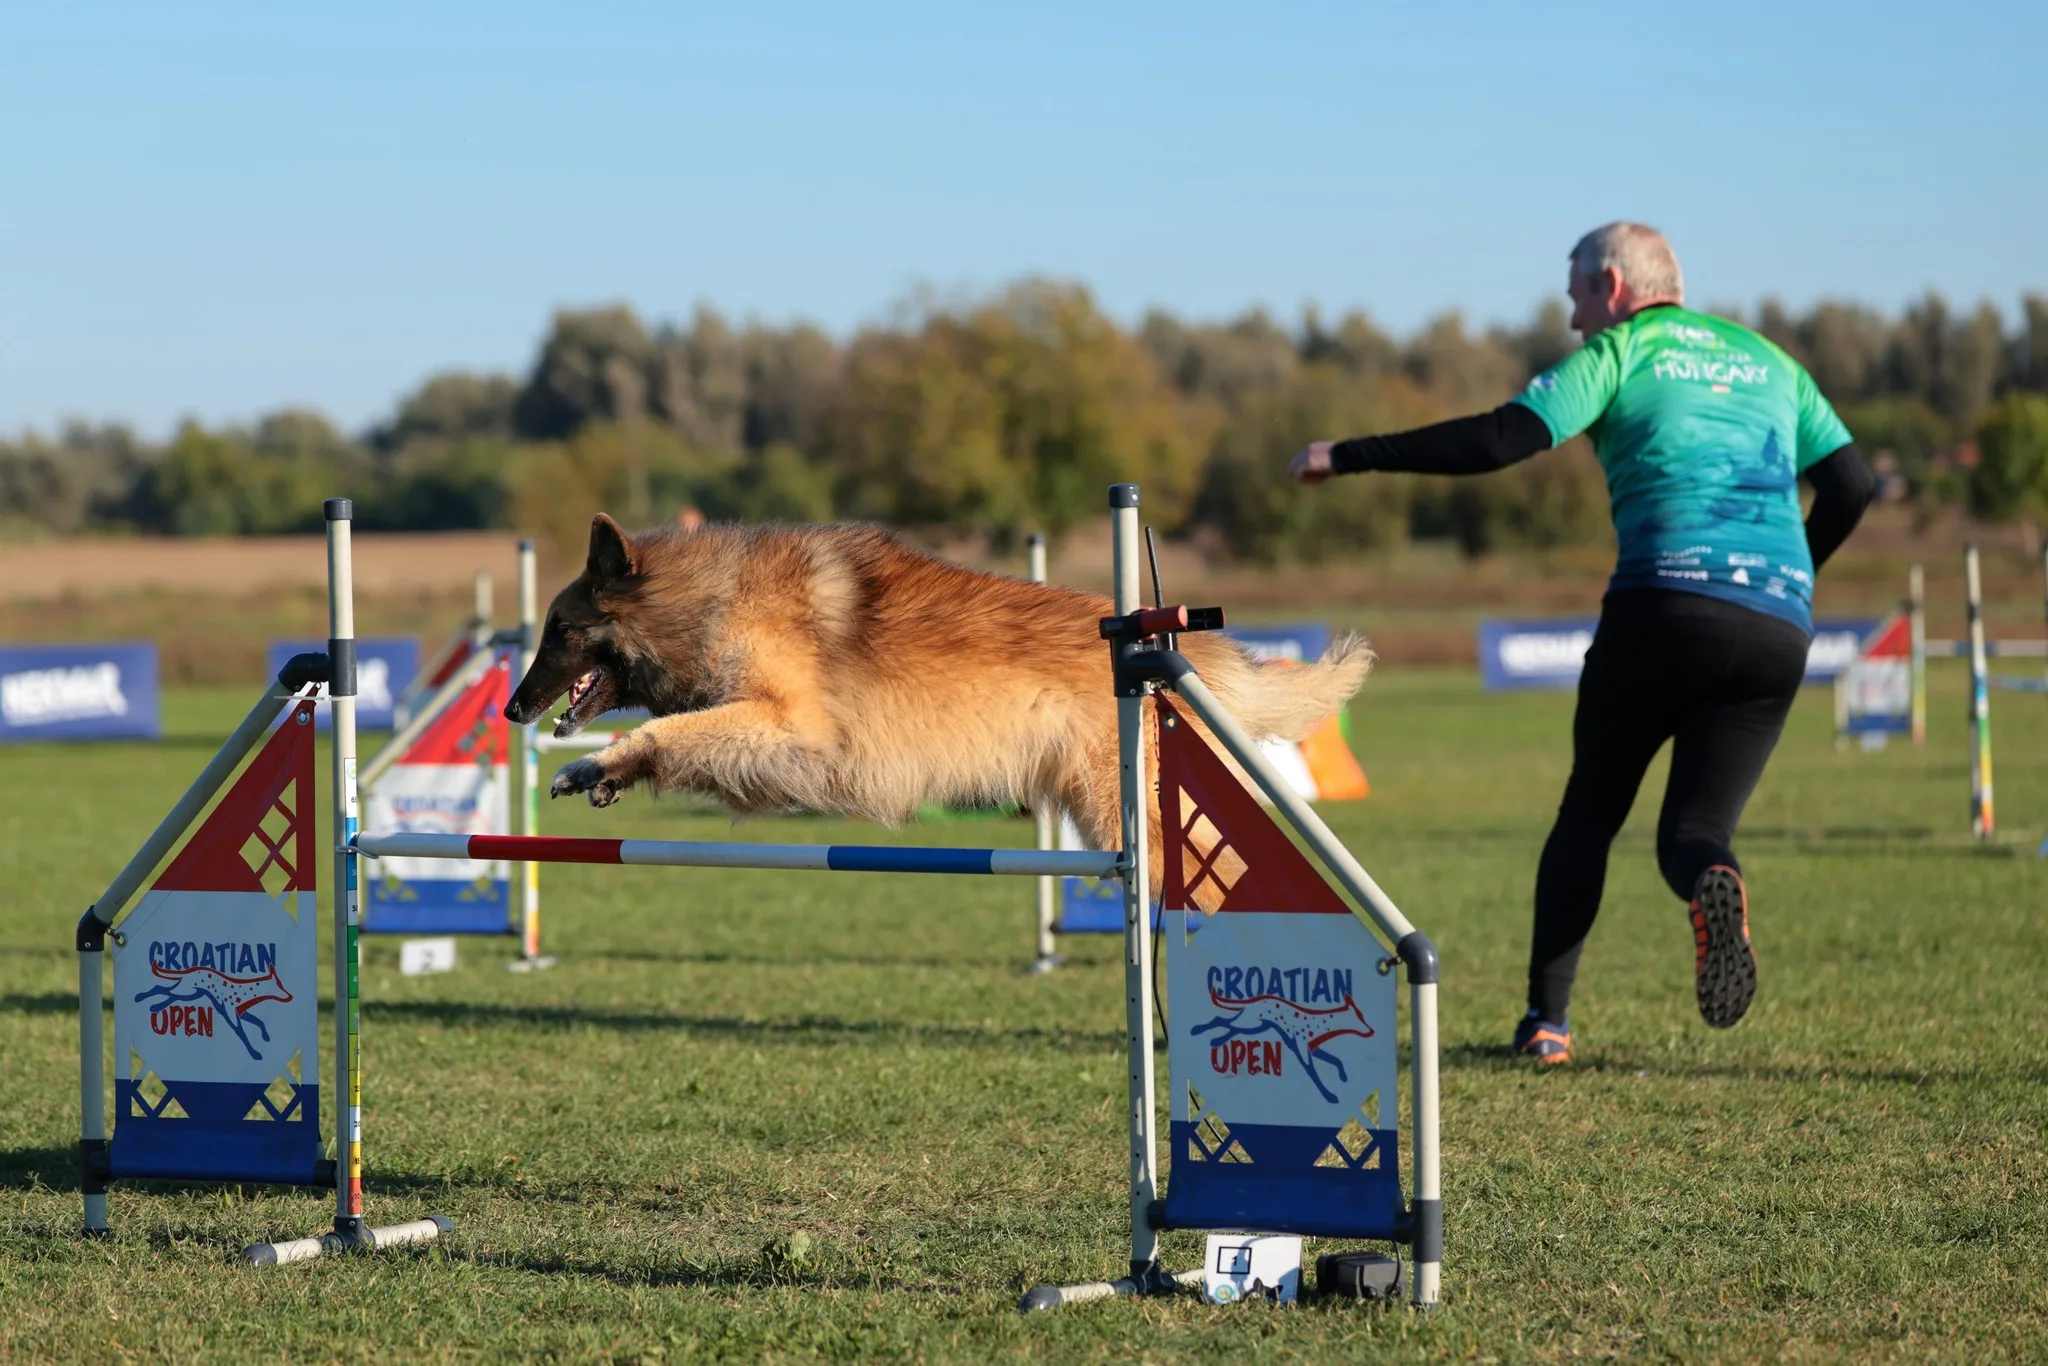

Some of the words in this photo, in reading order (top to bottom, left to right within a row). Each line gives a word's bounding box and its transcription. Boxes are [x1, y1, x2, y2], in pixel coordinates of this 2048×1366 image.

[148, 940, 276, 974] CROATIAN
[1207, 965, 1352, 1004] CROATIAN
[150, 1004, 213, 1038] OPEN
[1210, 1039, 1282, 1077] OPEN
[1231, 1255, 1238, 1266] 1
